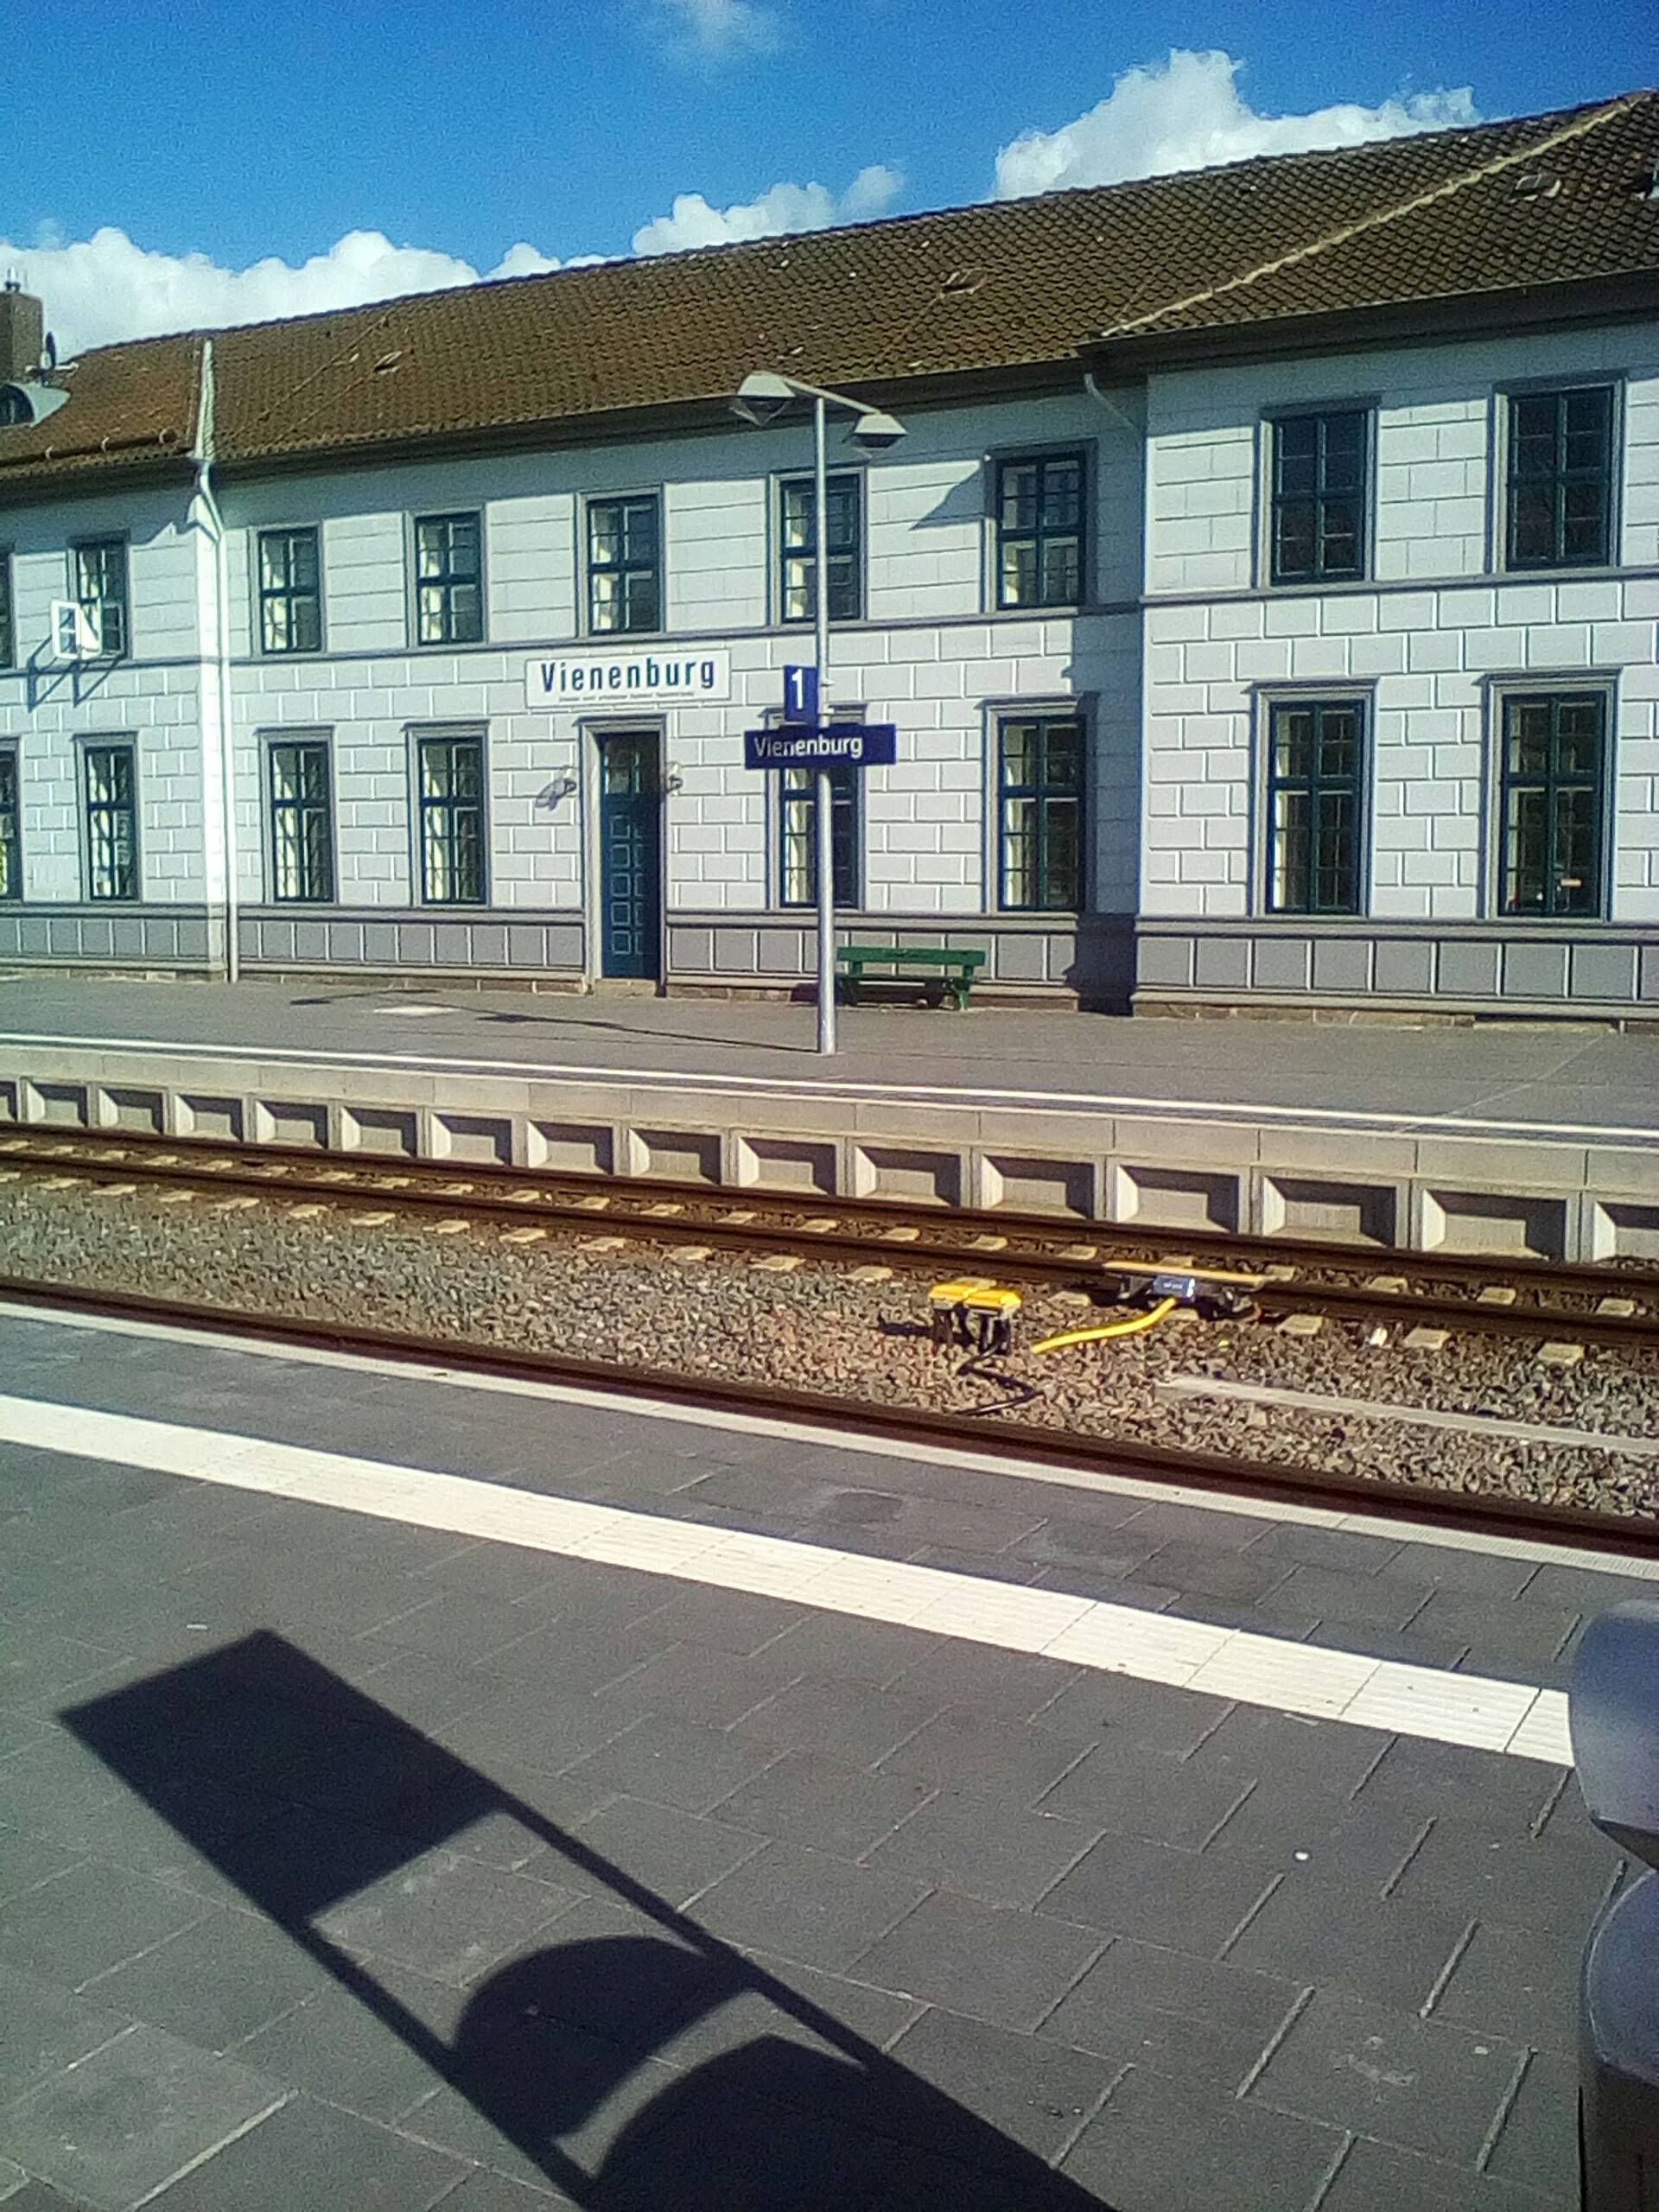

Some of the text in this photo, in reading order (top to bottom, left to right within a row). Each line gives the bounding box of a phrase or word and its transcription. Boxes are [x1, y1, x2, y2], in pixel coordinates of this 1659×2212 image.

[541, 658, 714, 692] Vienenburg
[791, 669, 804, 709] 1
[753, 734, 862, 760] Vienenburg
